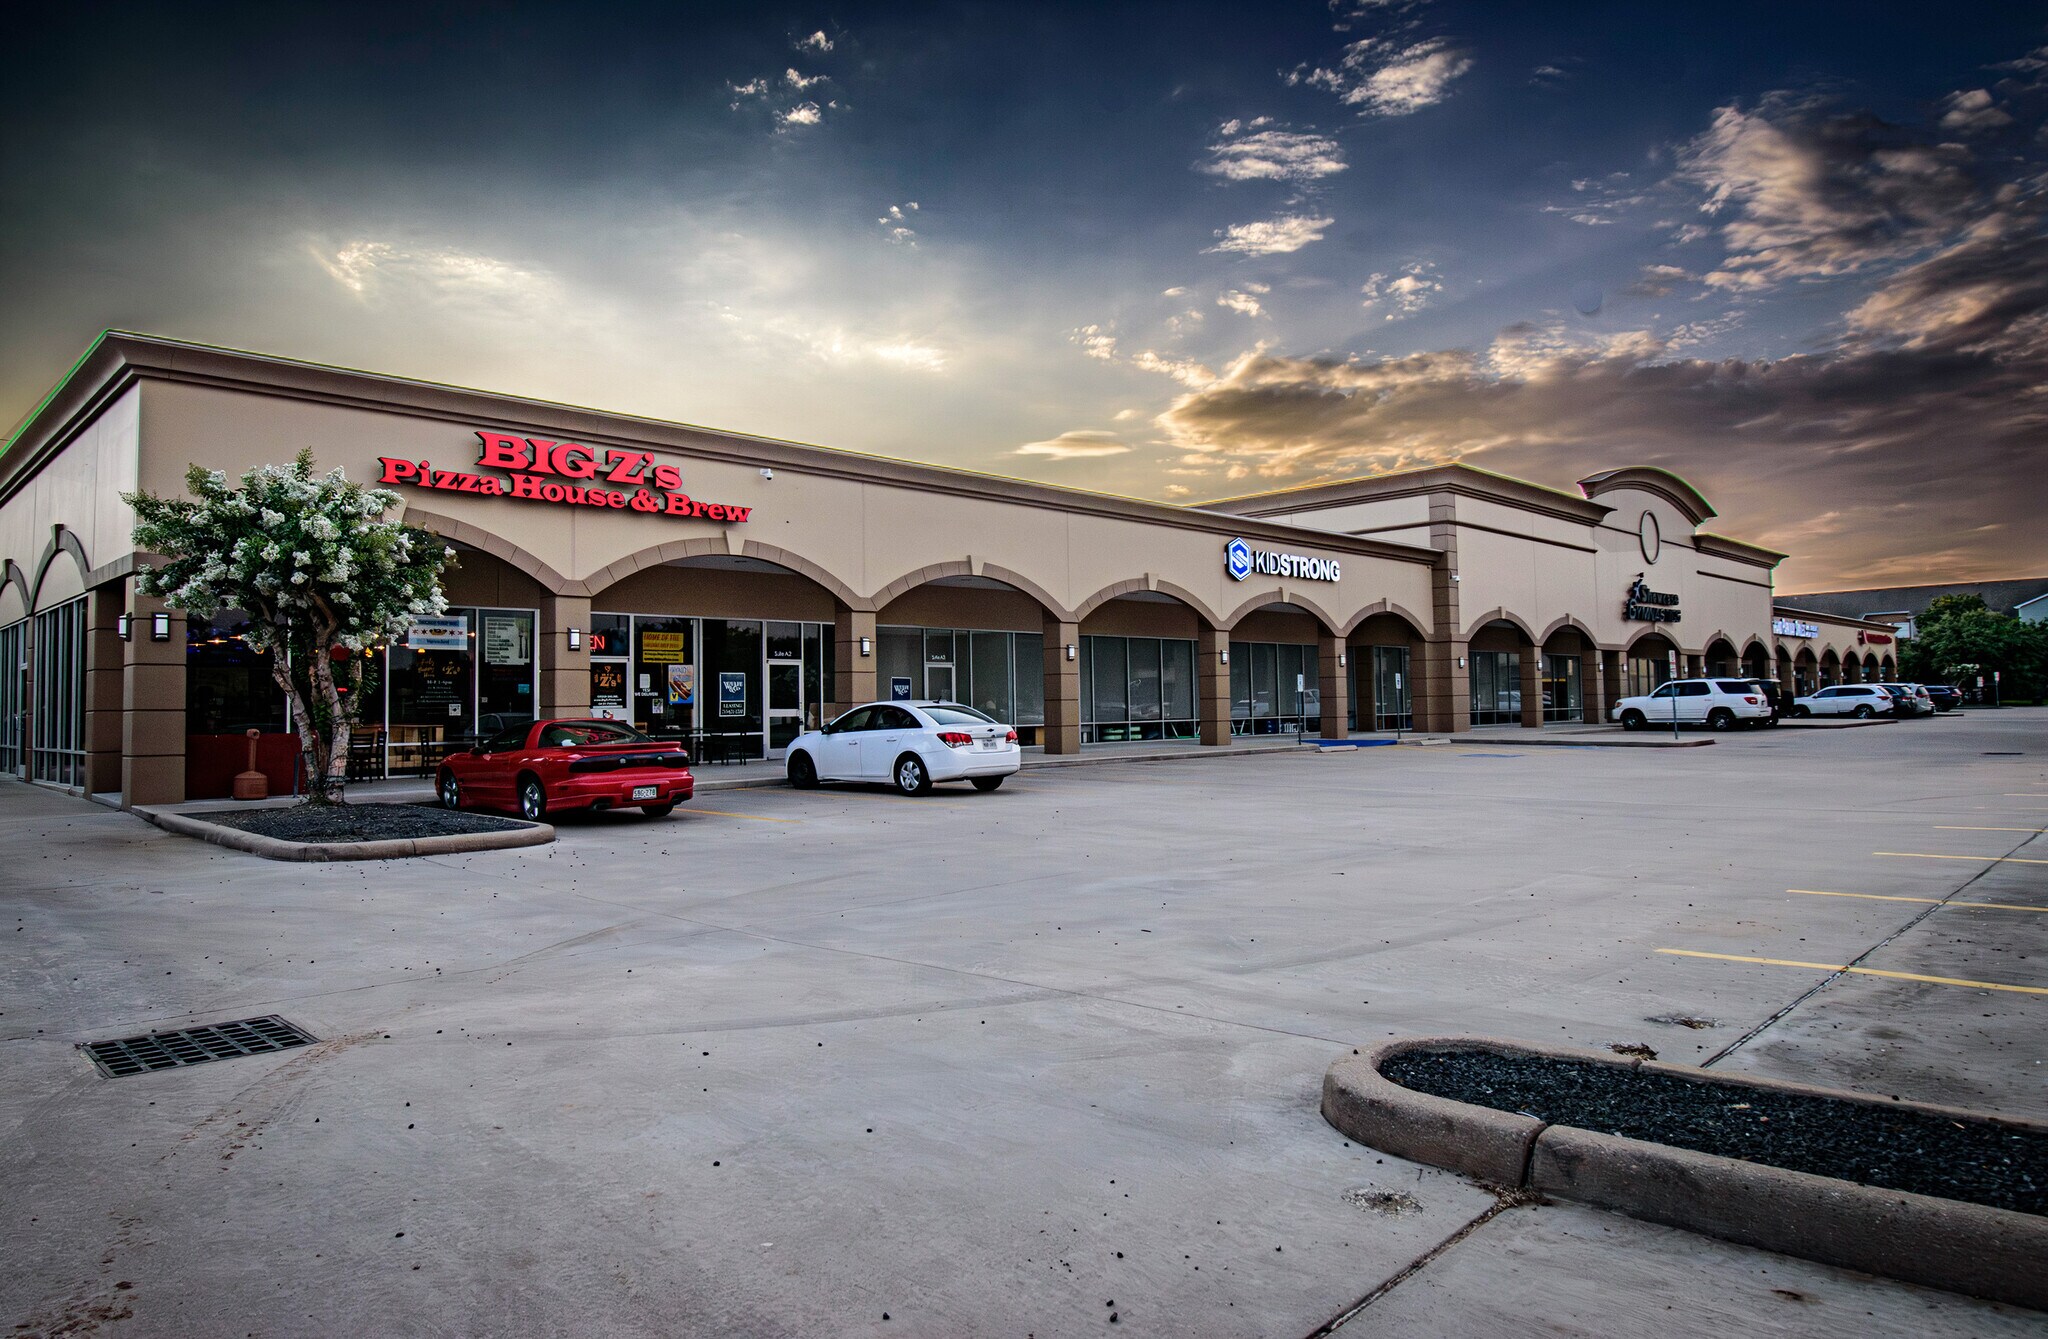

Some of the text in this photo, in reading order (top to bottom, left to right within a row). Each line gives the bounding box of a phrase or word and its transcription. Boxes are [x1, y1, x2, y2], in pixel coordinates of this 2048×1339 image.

[377, 456, 753, 523] Pizza House & Brew
[474, 431, 684, 491] BIG Z's
[1255, 550, 1341, 582] KIDSTRONG
